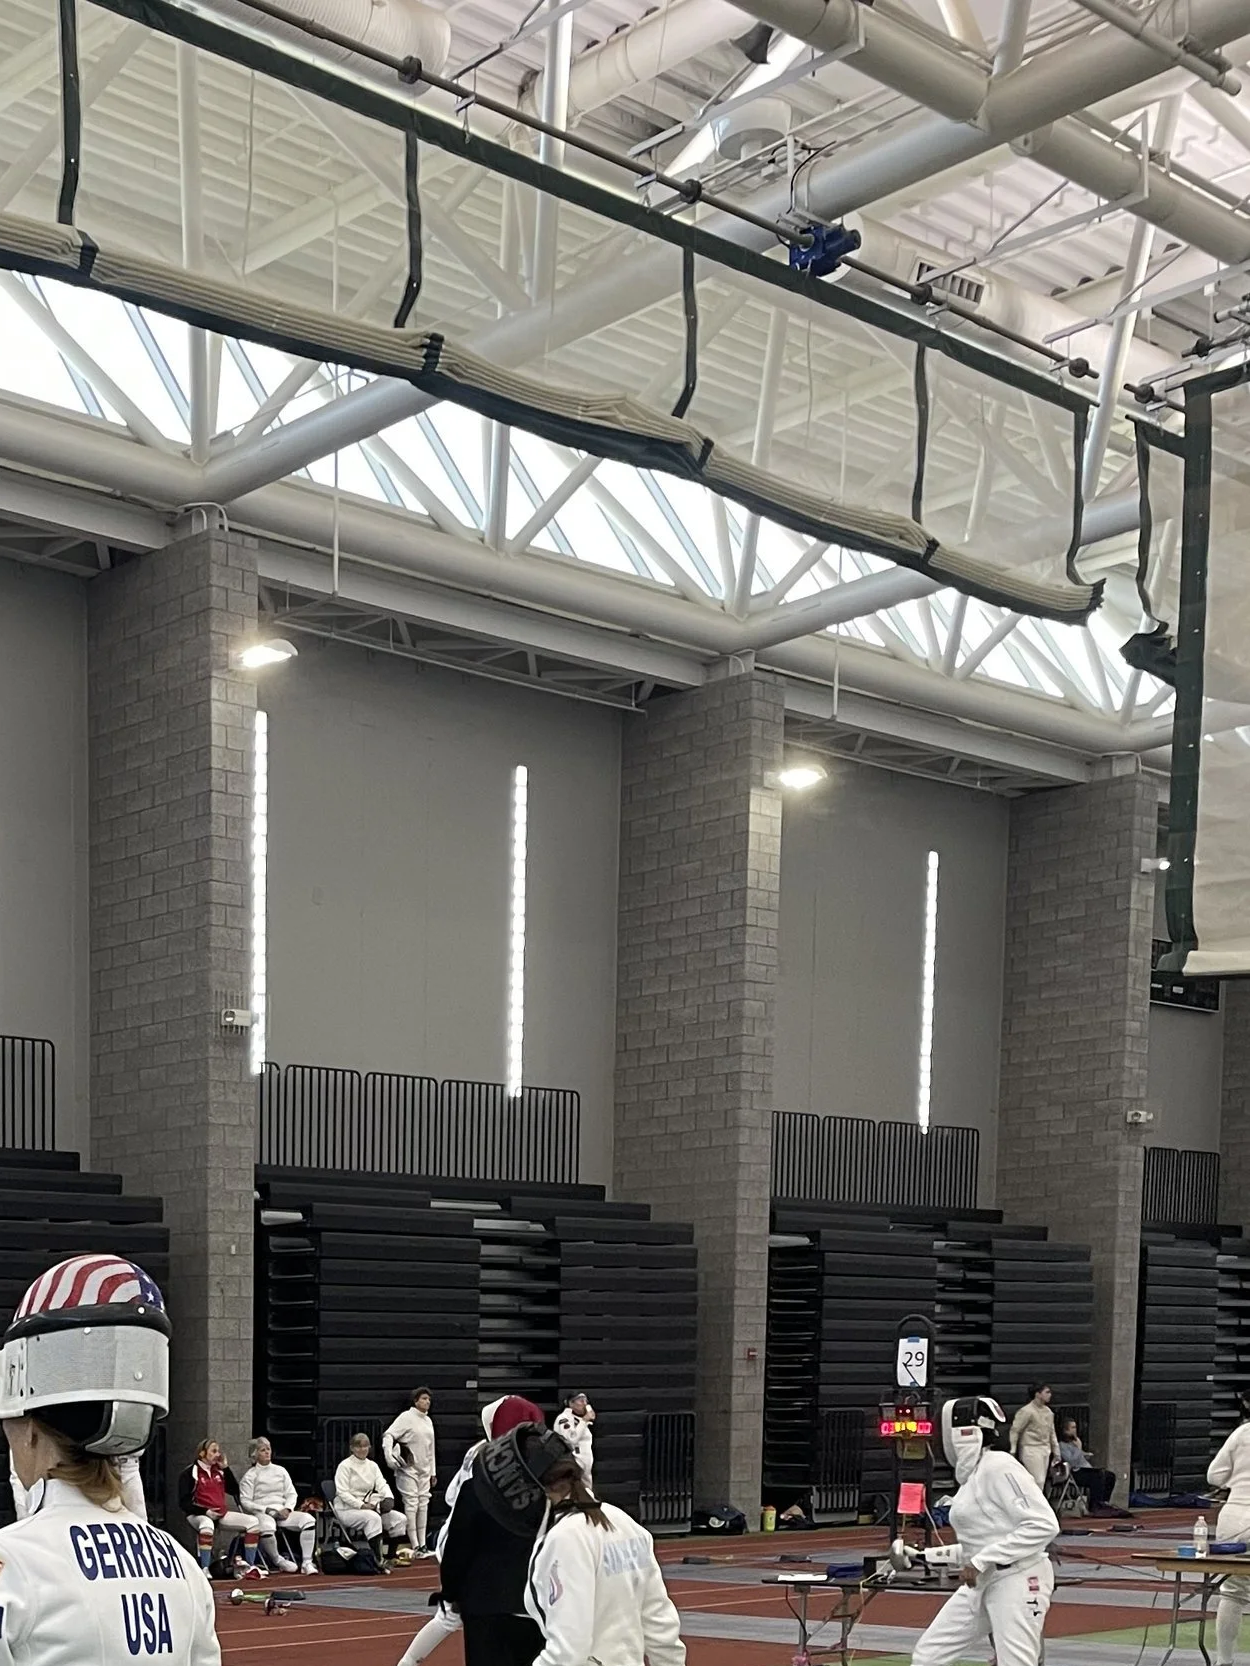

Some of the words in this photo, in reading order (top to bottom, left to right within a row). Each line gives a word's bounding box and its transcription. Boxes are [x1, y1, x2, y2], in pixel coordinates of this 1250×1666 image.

[903, 1351, 925, 1367] 29
[69, 1522, 186, 1581] GERRISH
[121, 1592, 173, 1656] USA
